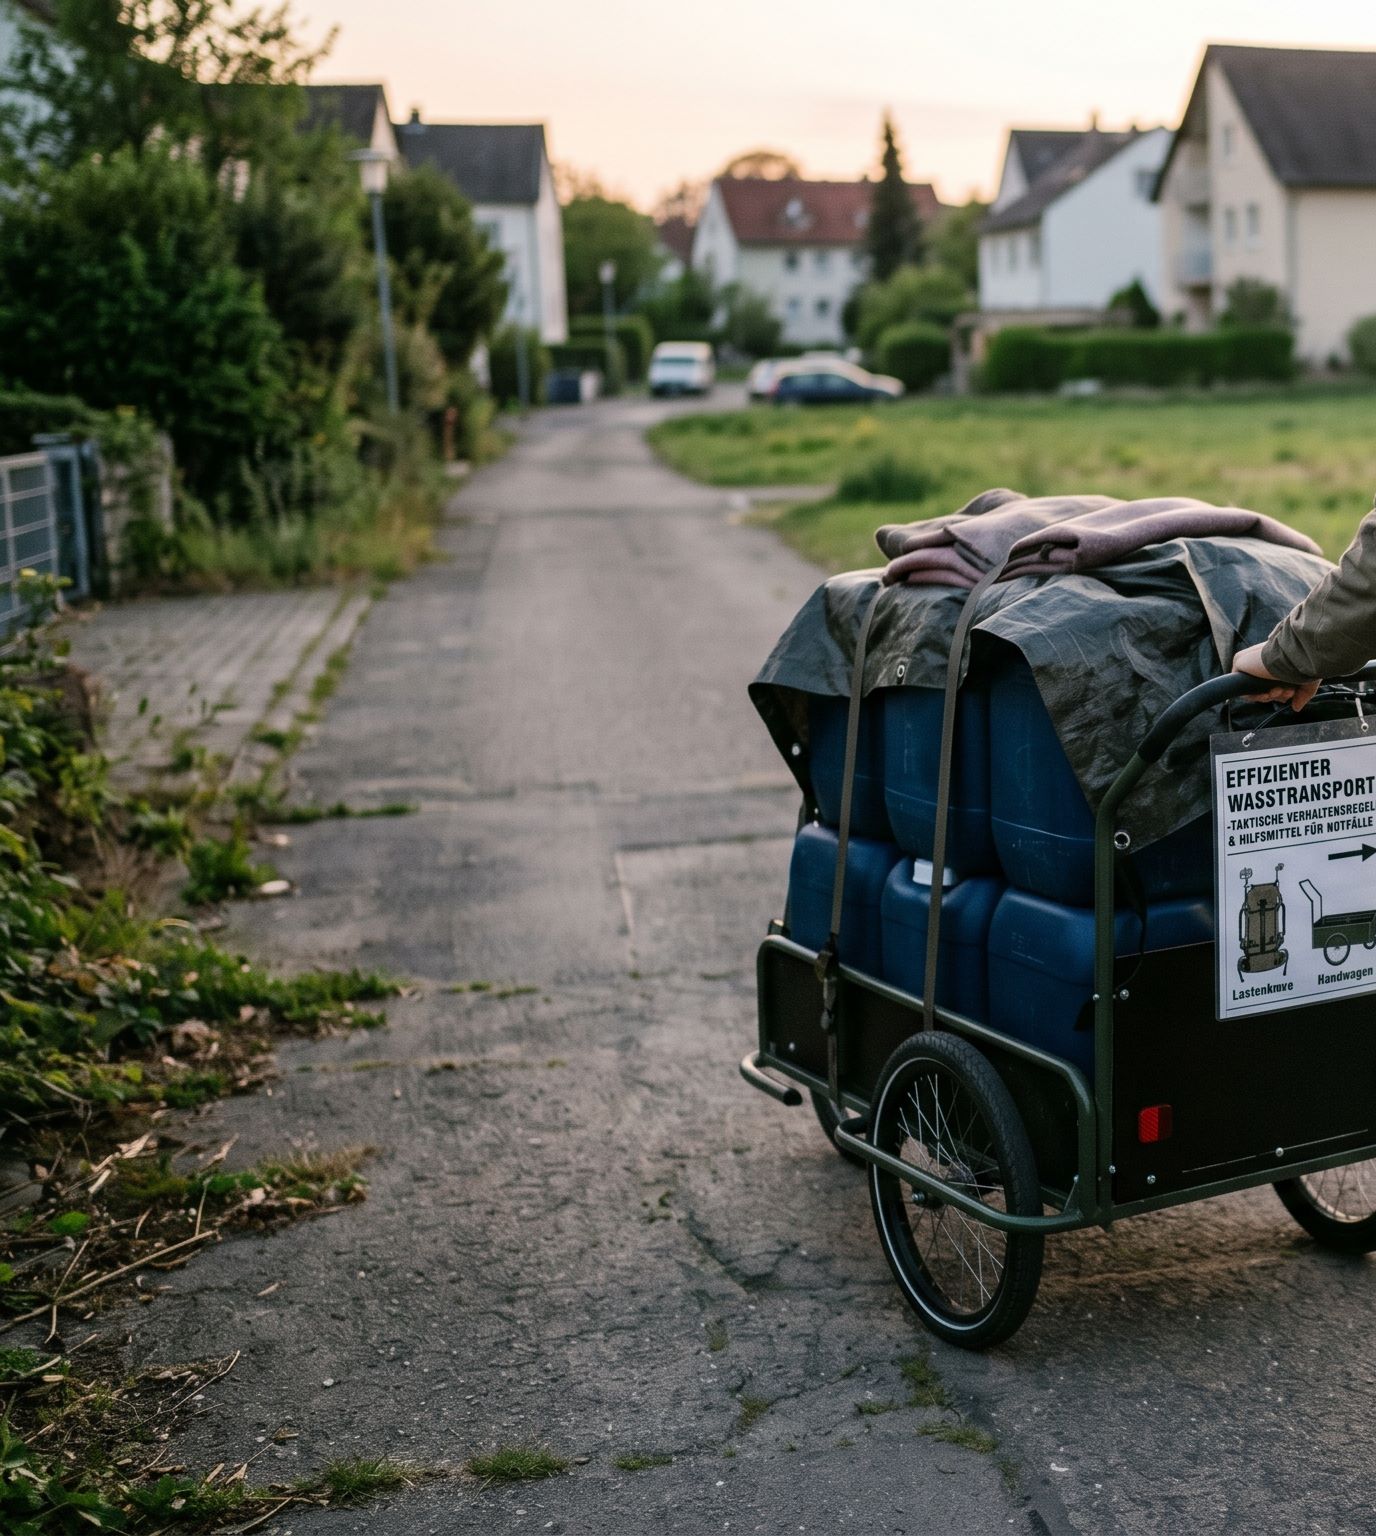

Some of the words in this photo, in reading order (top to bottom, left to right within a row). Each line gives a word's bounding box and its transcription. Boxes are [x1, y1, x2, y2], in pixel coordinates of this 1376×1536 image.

[1226, 758, 1331, 789] EFFIZIENTER
[1227, 813, 1284, 831] -TAKTISCHE
[1228, 835, 1236, 847] &
[1239, 826, 1302, 846] HILFSMITTEL
[1304, 820, 1324, 837] FÜR
[1326, 815, 1374, 833] NOTFÄLLE
[1317, 967, 1374, 986] Handwagen
